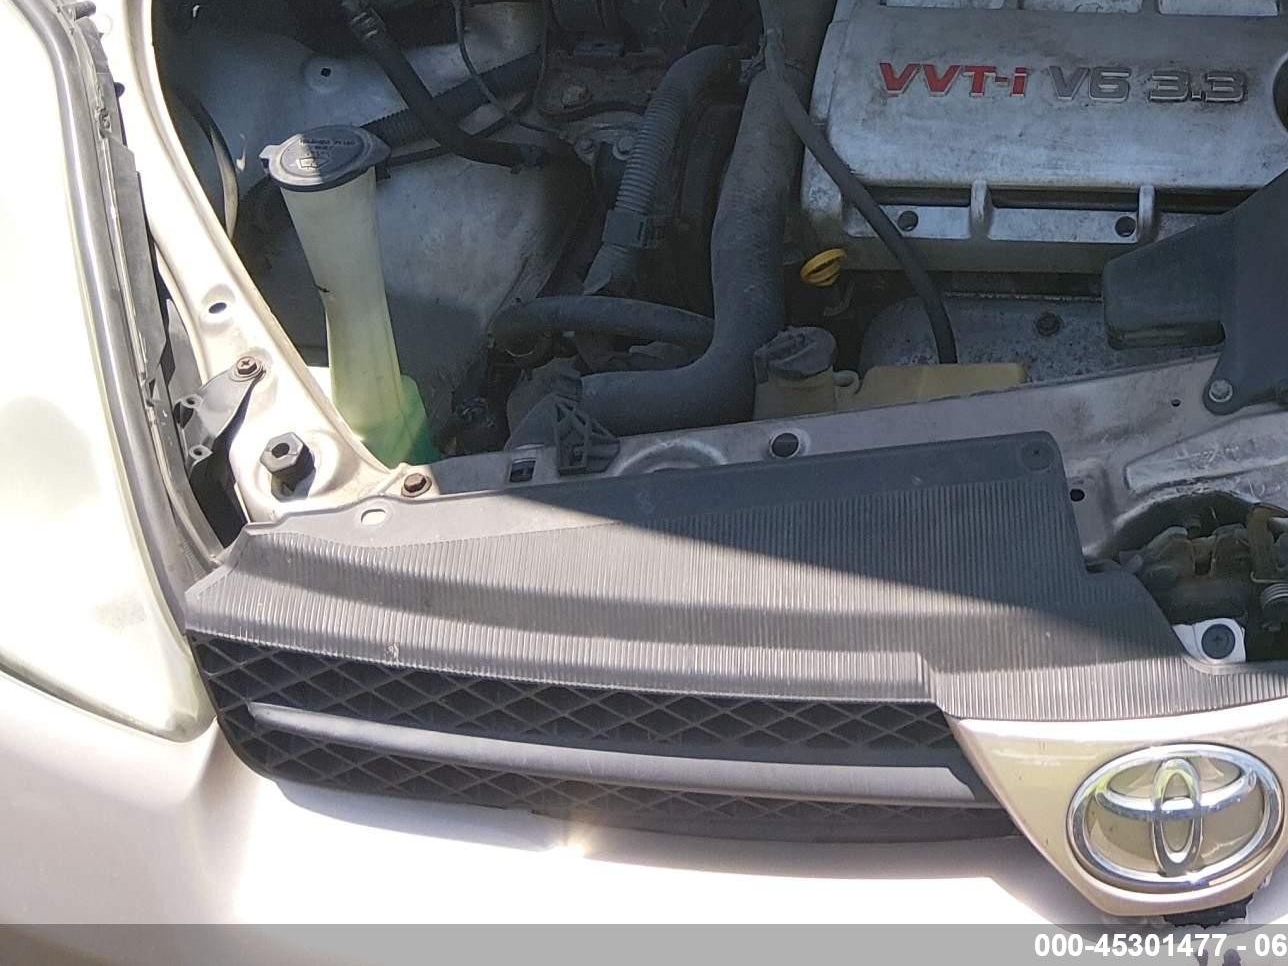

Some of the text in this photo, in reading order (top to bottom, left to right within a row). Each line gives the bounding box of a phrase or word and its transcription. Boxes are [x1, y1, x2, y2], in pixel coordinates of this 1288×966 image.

[879, 62, 1246, 104] VVT-i V6 3.3
